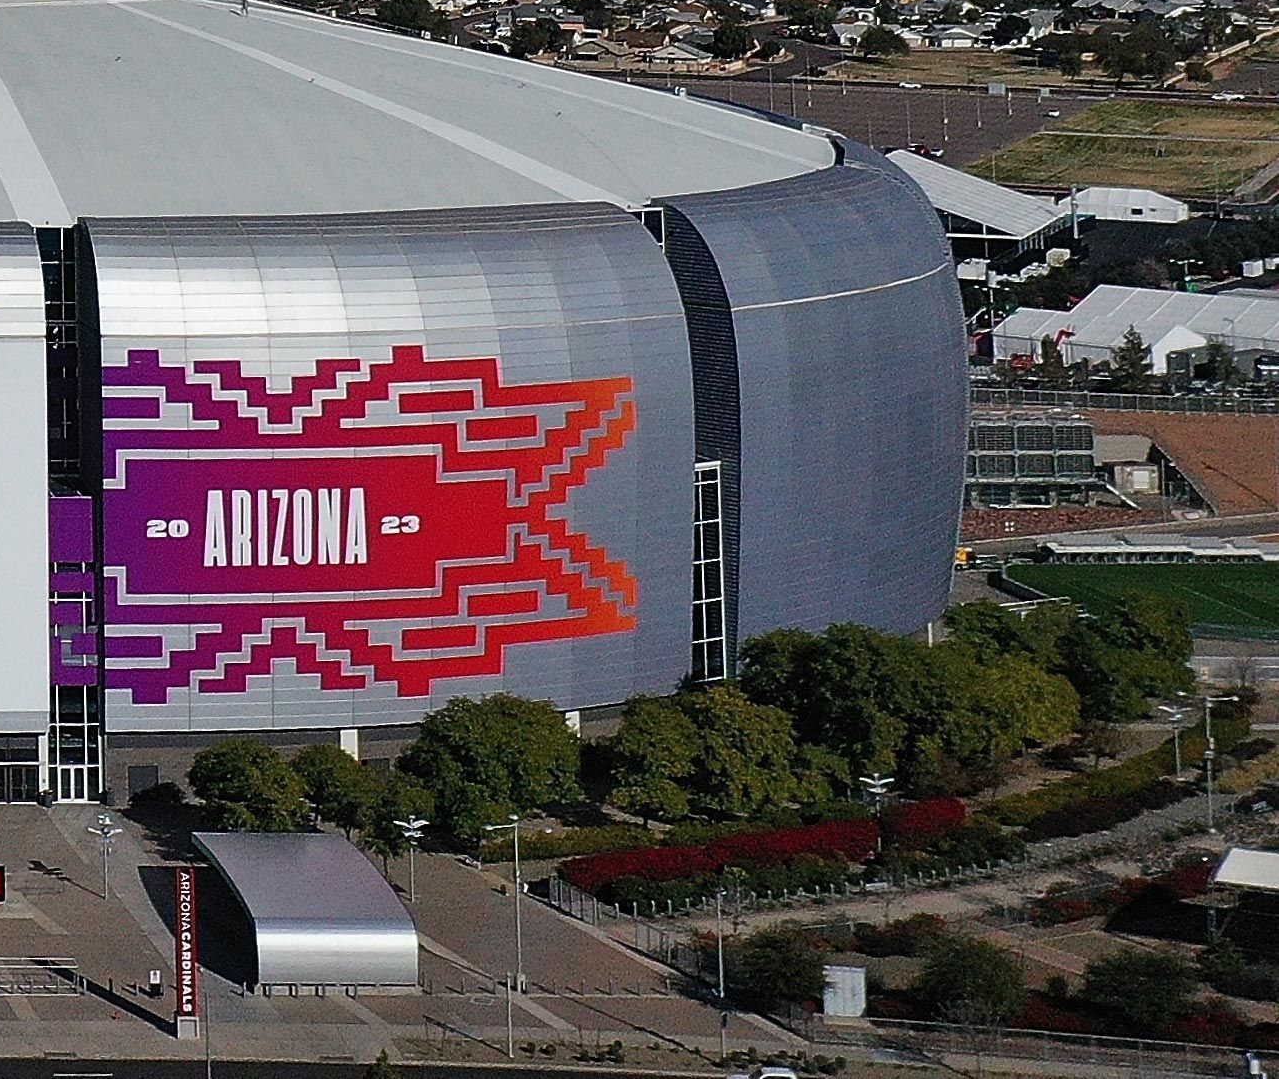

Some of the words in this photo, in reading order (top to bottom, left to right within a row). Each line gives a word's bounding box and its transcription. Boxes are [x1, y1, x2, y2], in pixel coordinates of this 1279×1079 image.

[146, 519, 189, 538] 20
[203, 487, 367, 566] ARIZONA
[380, 515, 420, 534] 23
